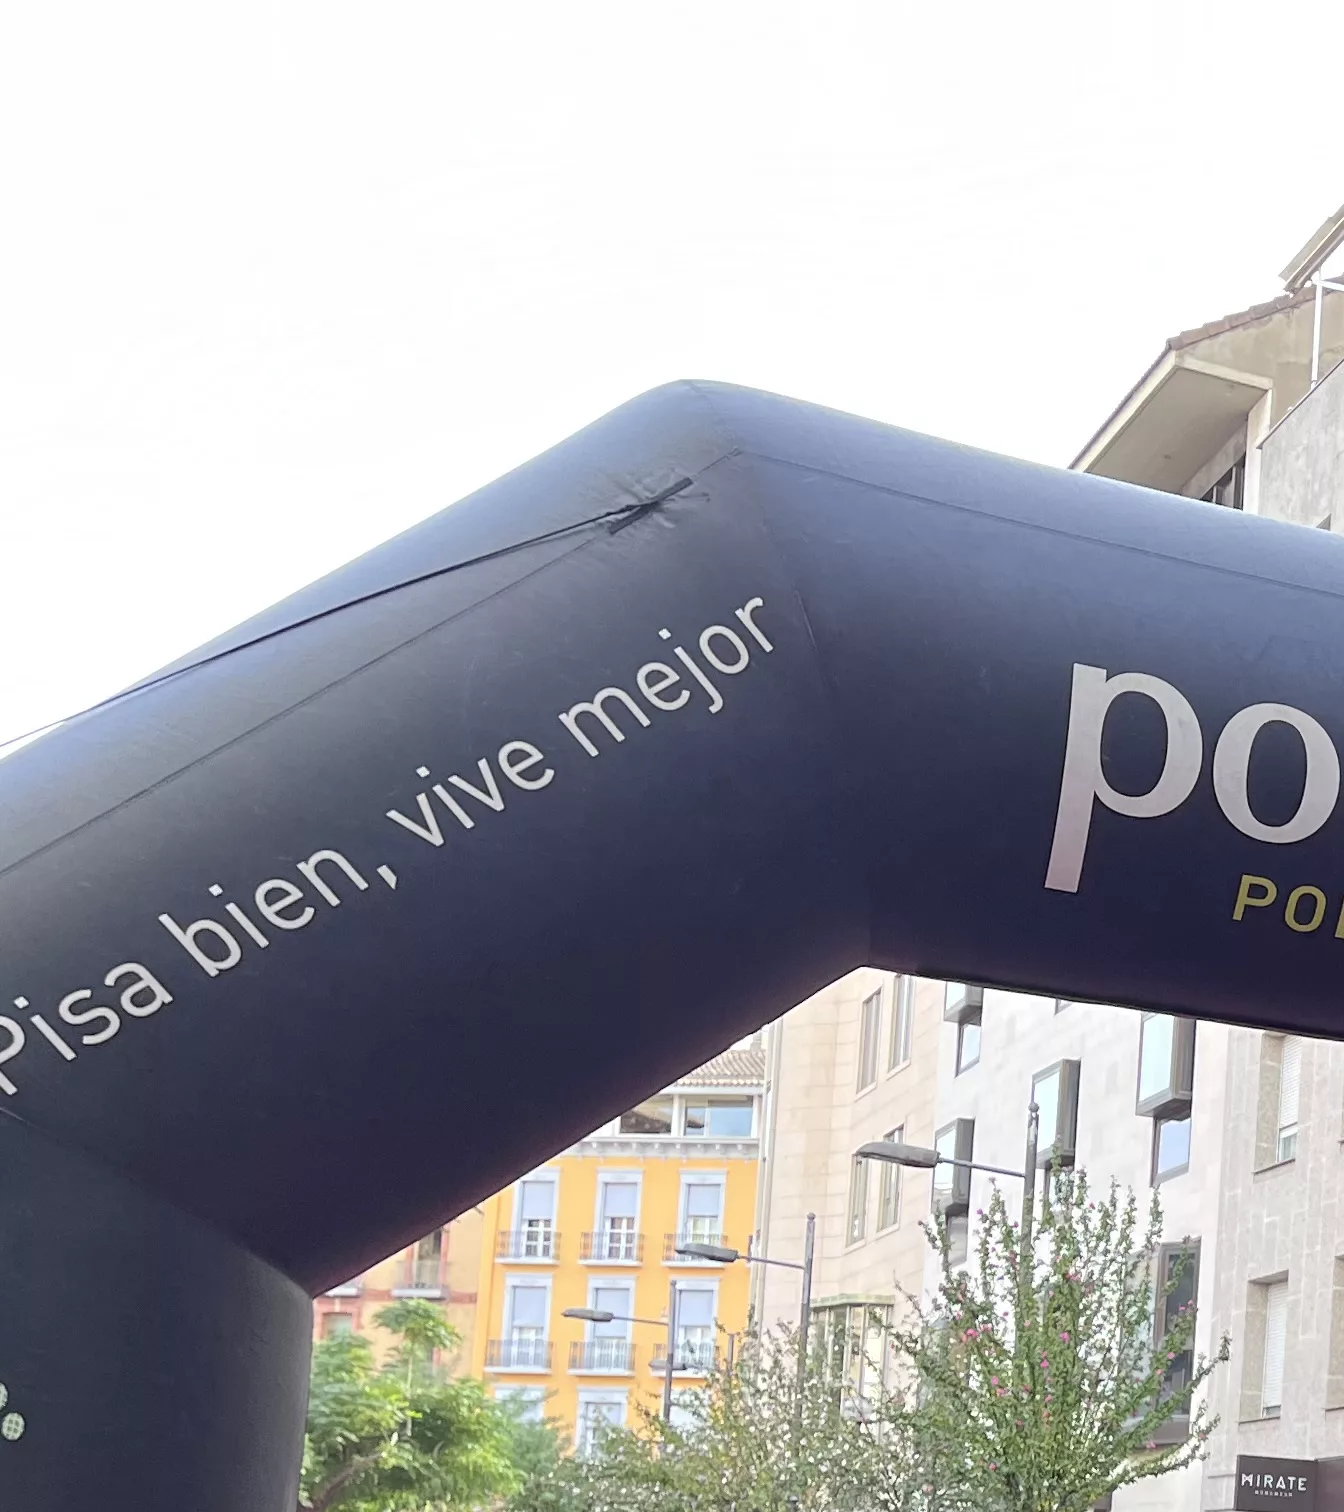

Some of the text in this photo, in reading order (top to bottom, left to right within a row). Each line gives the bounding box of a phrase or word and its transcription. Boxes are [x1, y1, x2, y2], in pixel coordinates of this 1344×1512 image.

[158, 846, 399, 978] bien,
[386, 738, 556, 849] vive
[557, 594, 777, 759] mejor
[1241, 1472, 1308, 1492] MIRATE
